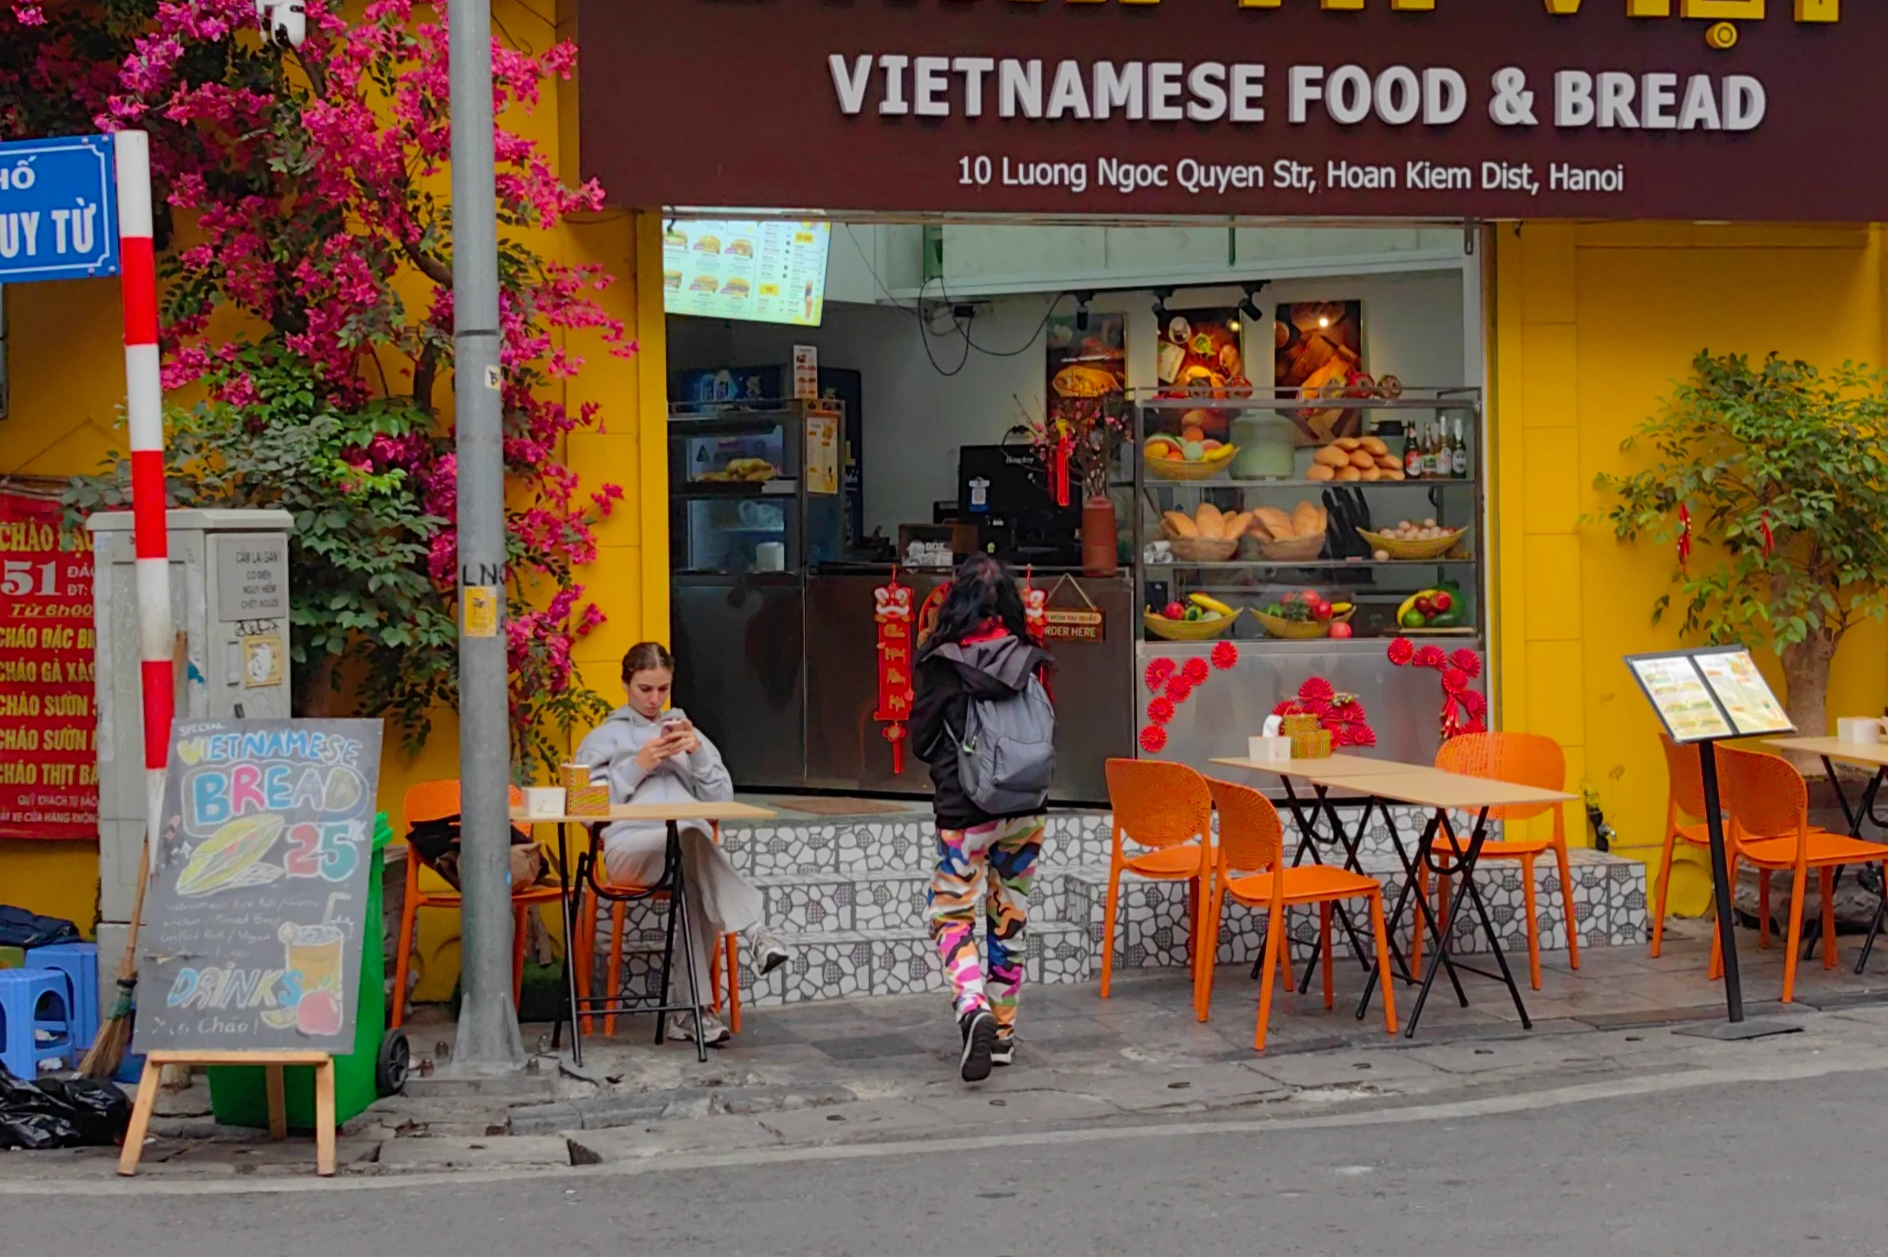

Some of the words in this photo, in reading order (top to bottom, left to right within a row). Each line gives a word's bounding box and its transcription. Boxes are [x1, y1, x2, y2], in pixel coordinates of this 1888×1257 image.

[828, 53, 1265, 122] VIETNAMESE
[1288, 64, 1468, 125] FOOD
[1488, 67, 1539, 127] &
[1554, 69, 1767, 131] BREAD
[958, 155, 992, 186] 10
[1002, 156, 1087, 192] Luong
[1098, 157, 1168, 193] Ngoc
[1177, 158, 1264, 194] Quyen
[1273, 159, 1316, 194] Str,
[1327, 161, 1396, 189] Hoan
[1406, 162, 1472, 190] Kiem
[1482, 163, 1540, 196] Dist,
[1550, 164, 1624, 192] Hanoi
[51, 197, 97, 254] TỪ
[1, 559, 61, 596] 51
[1071, 626, 1096, 637] HERE
[41, 657, 62, 683] GÀ
[177, 728, 363, 768] VIETNAMESE
[178, 721, 226, 737] SPECIAL
[192, 763, 363, 826] BREAD
